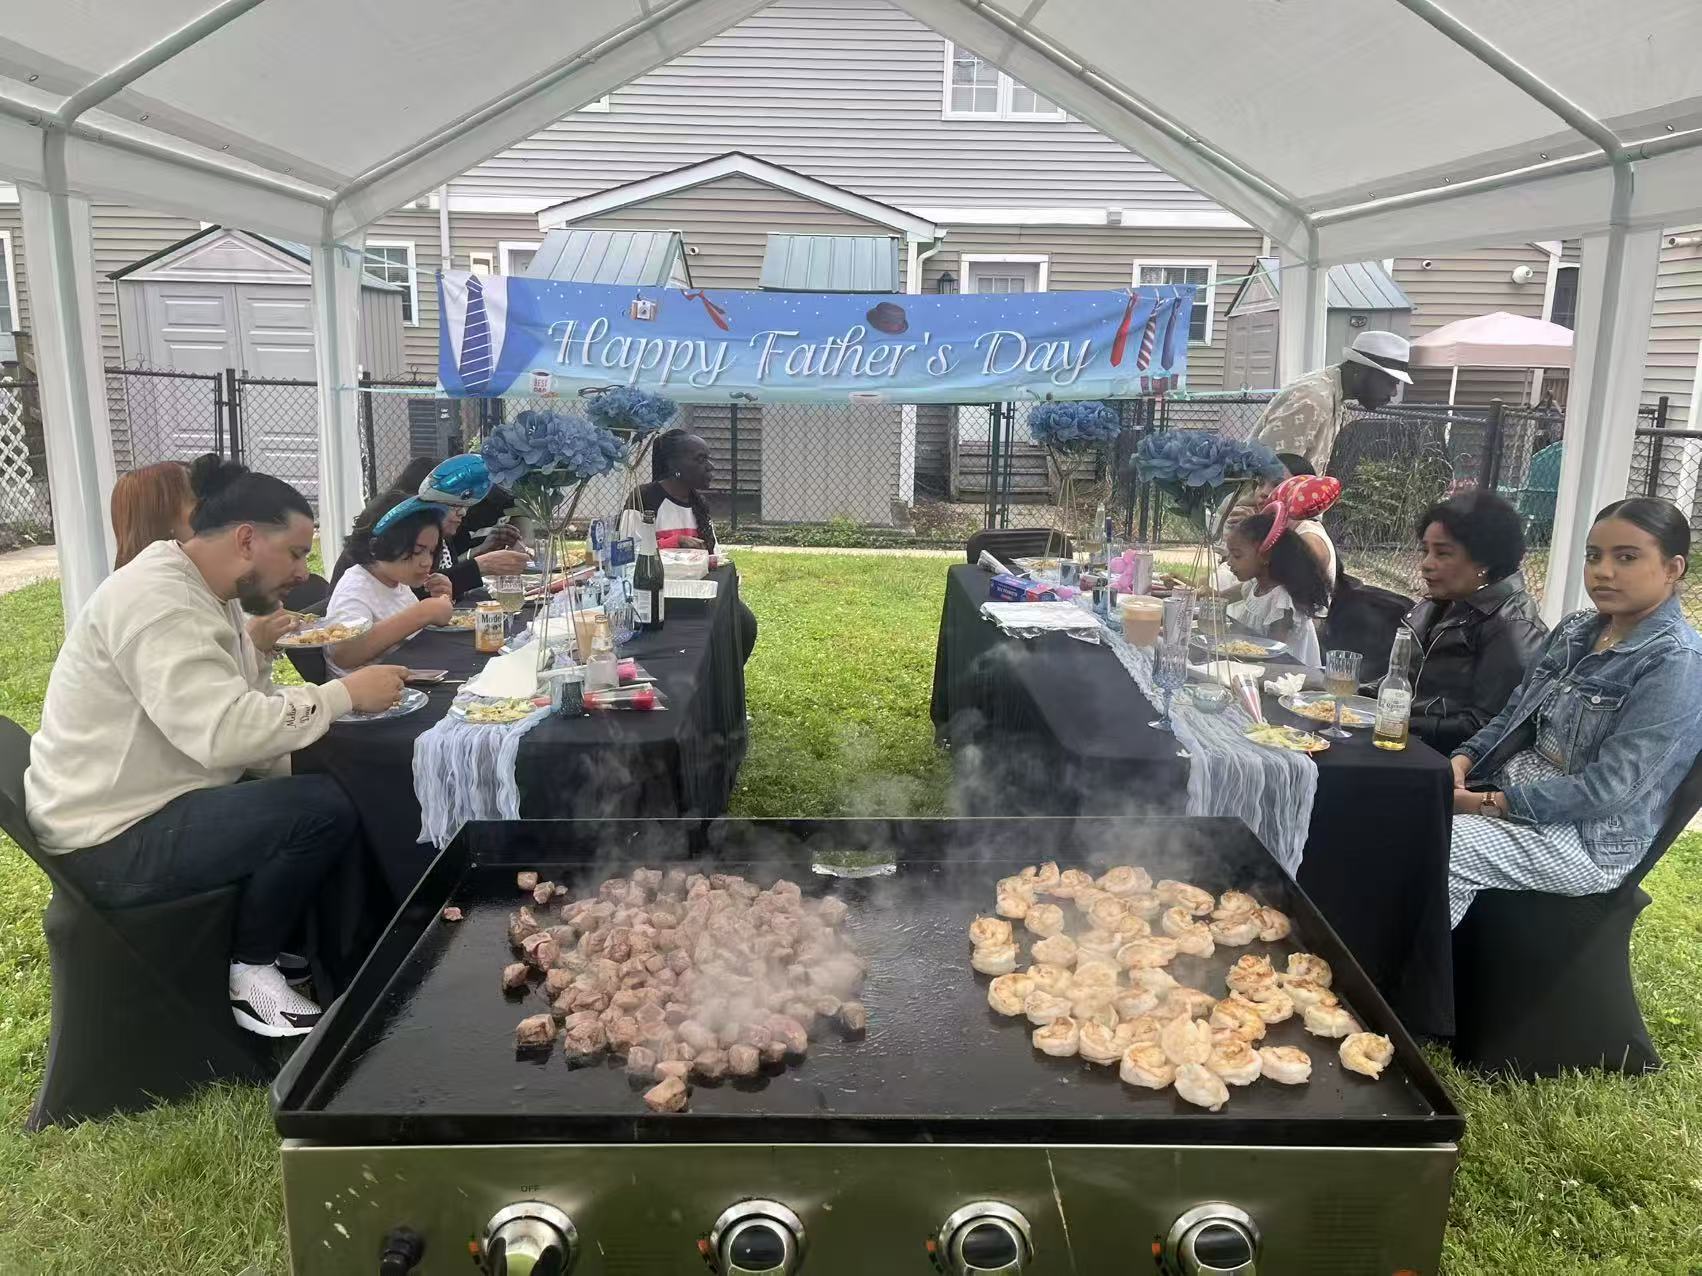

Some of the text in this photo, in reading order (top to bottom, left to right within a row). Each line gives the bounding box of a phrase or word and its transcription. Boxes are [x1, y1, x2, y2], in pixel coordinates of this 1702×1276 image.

[548, 317, 1100, 388] Happy Father's Day
[520, 1184, 540, 1193] OFF
